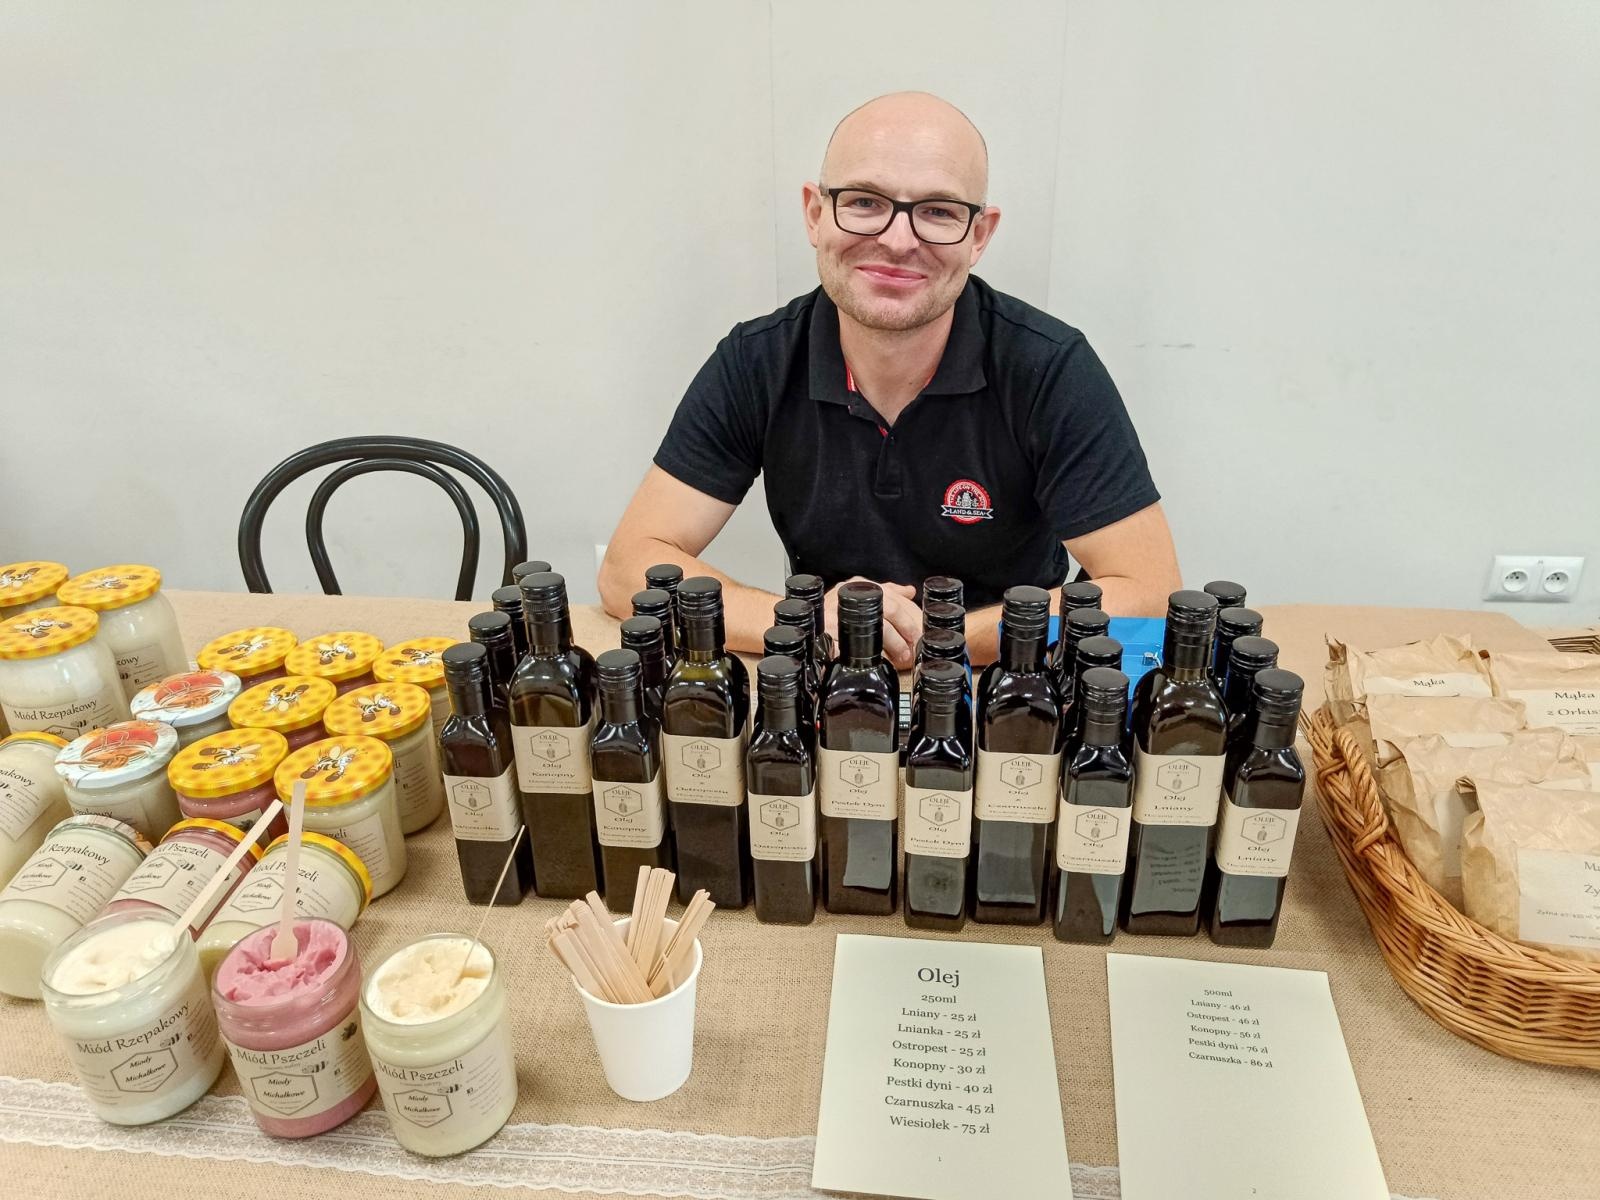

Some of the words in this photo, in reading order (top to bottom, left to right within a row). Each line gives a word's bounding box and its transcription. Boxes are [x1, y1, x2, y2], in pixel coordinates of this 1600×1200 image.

[13, 709, 37, 722] Miód
[39, 699, 98, 721] Rzepakowy
[49, 843, 111, 867] Rzepakowy
[168, 842, 209, 860] Pszczeli
[917, 967, 960, 988] Olej
[921, 994, 957, 1004] 250ml
[1203, 989, 1233, 997] 500ml
[1191, 999, 1221, 1010] Lniany
[902, 1007, 940, 1020] Lniany
[951, 1013, 964, 1022] 25
[967, 1013, 977, 1021] zł
[1186, 1011, 1230, 1022] Ostropest
[76, 1040, 113, 1054] Miód
[115, 1001, 189, 1050] Rzepakowy
[897, 1023, 943, 1036] Lnianka
[954, 1030, 968, 1039] 25
[971, 1030, 981, 1039] zł
[1190, 1025, 1231, 1036] Konopny
[1240, 1031, 1251, 1039] 56
[236, 1048, 268, 1065] Miód
[270, 1039, 327, 1065] Pszczeli
[892, 1040, 948, 1054] Ostropest
[959, 1048, 974, 1057] 25
[976, 1047, 986, 1056] zł
[1188, 1037, 1216, 1047] Pestki
[1218, 1041, 1239, 1051] dyni
[1260, 1046, 1269, 1054] zł
[893, 1058, 946, 1073] Konopny
[957, 1065, 973, 1075] 30
[976, 1065, 986, 1075] zł
[1188, 1051, 1242, 1065] Czarnuszka
[1250, 1059, 1263, 1068] 86
[1265, 1060, 1273, 1068] zł
[377, 1061, 407, 1081] Miód
[410, 1059, 464, 1081] Pszczeli
[268, 1078, 292, 1086] Miody
[886, 1076, 922, 1088] Pestki
[925, 1079, 952, 1091] dyni
[963, 1084, 979, 1094] 40
[982, 1084, 993, 1094] zł
[884, 1095, 954, 1111] Czarnuszka
[966, 1104, 981, 1114] 45
[984, 1103, 995, 1114] zł
[889, 1115, 951, 1130] Wiesiołek
[961, 1123, 977, 1135] 75
[979, 1123, 990, 1134] zł
